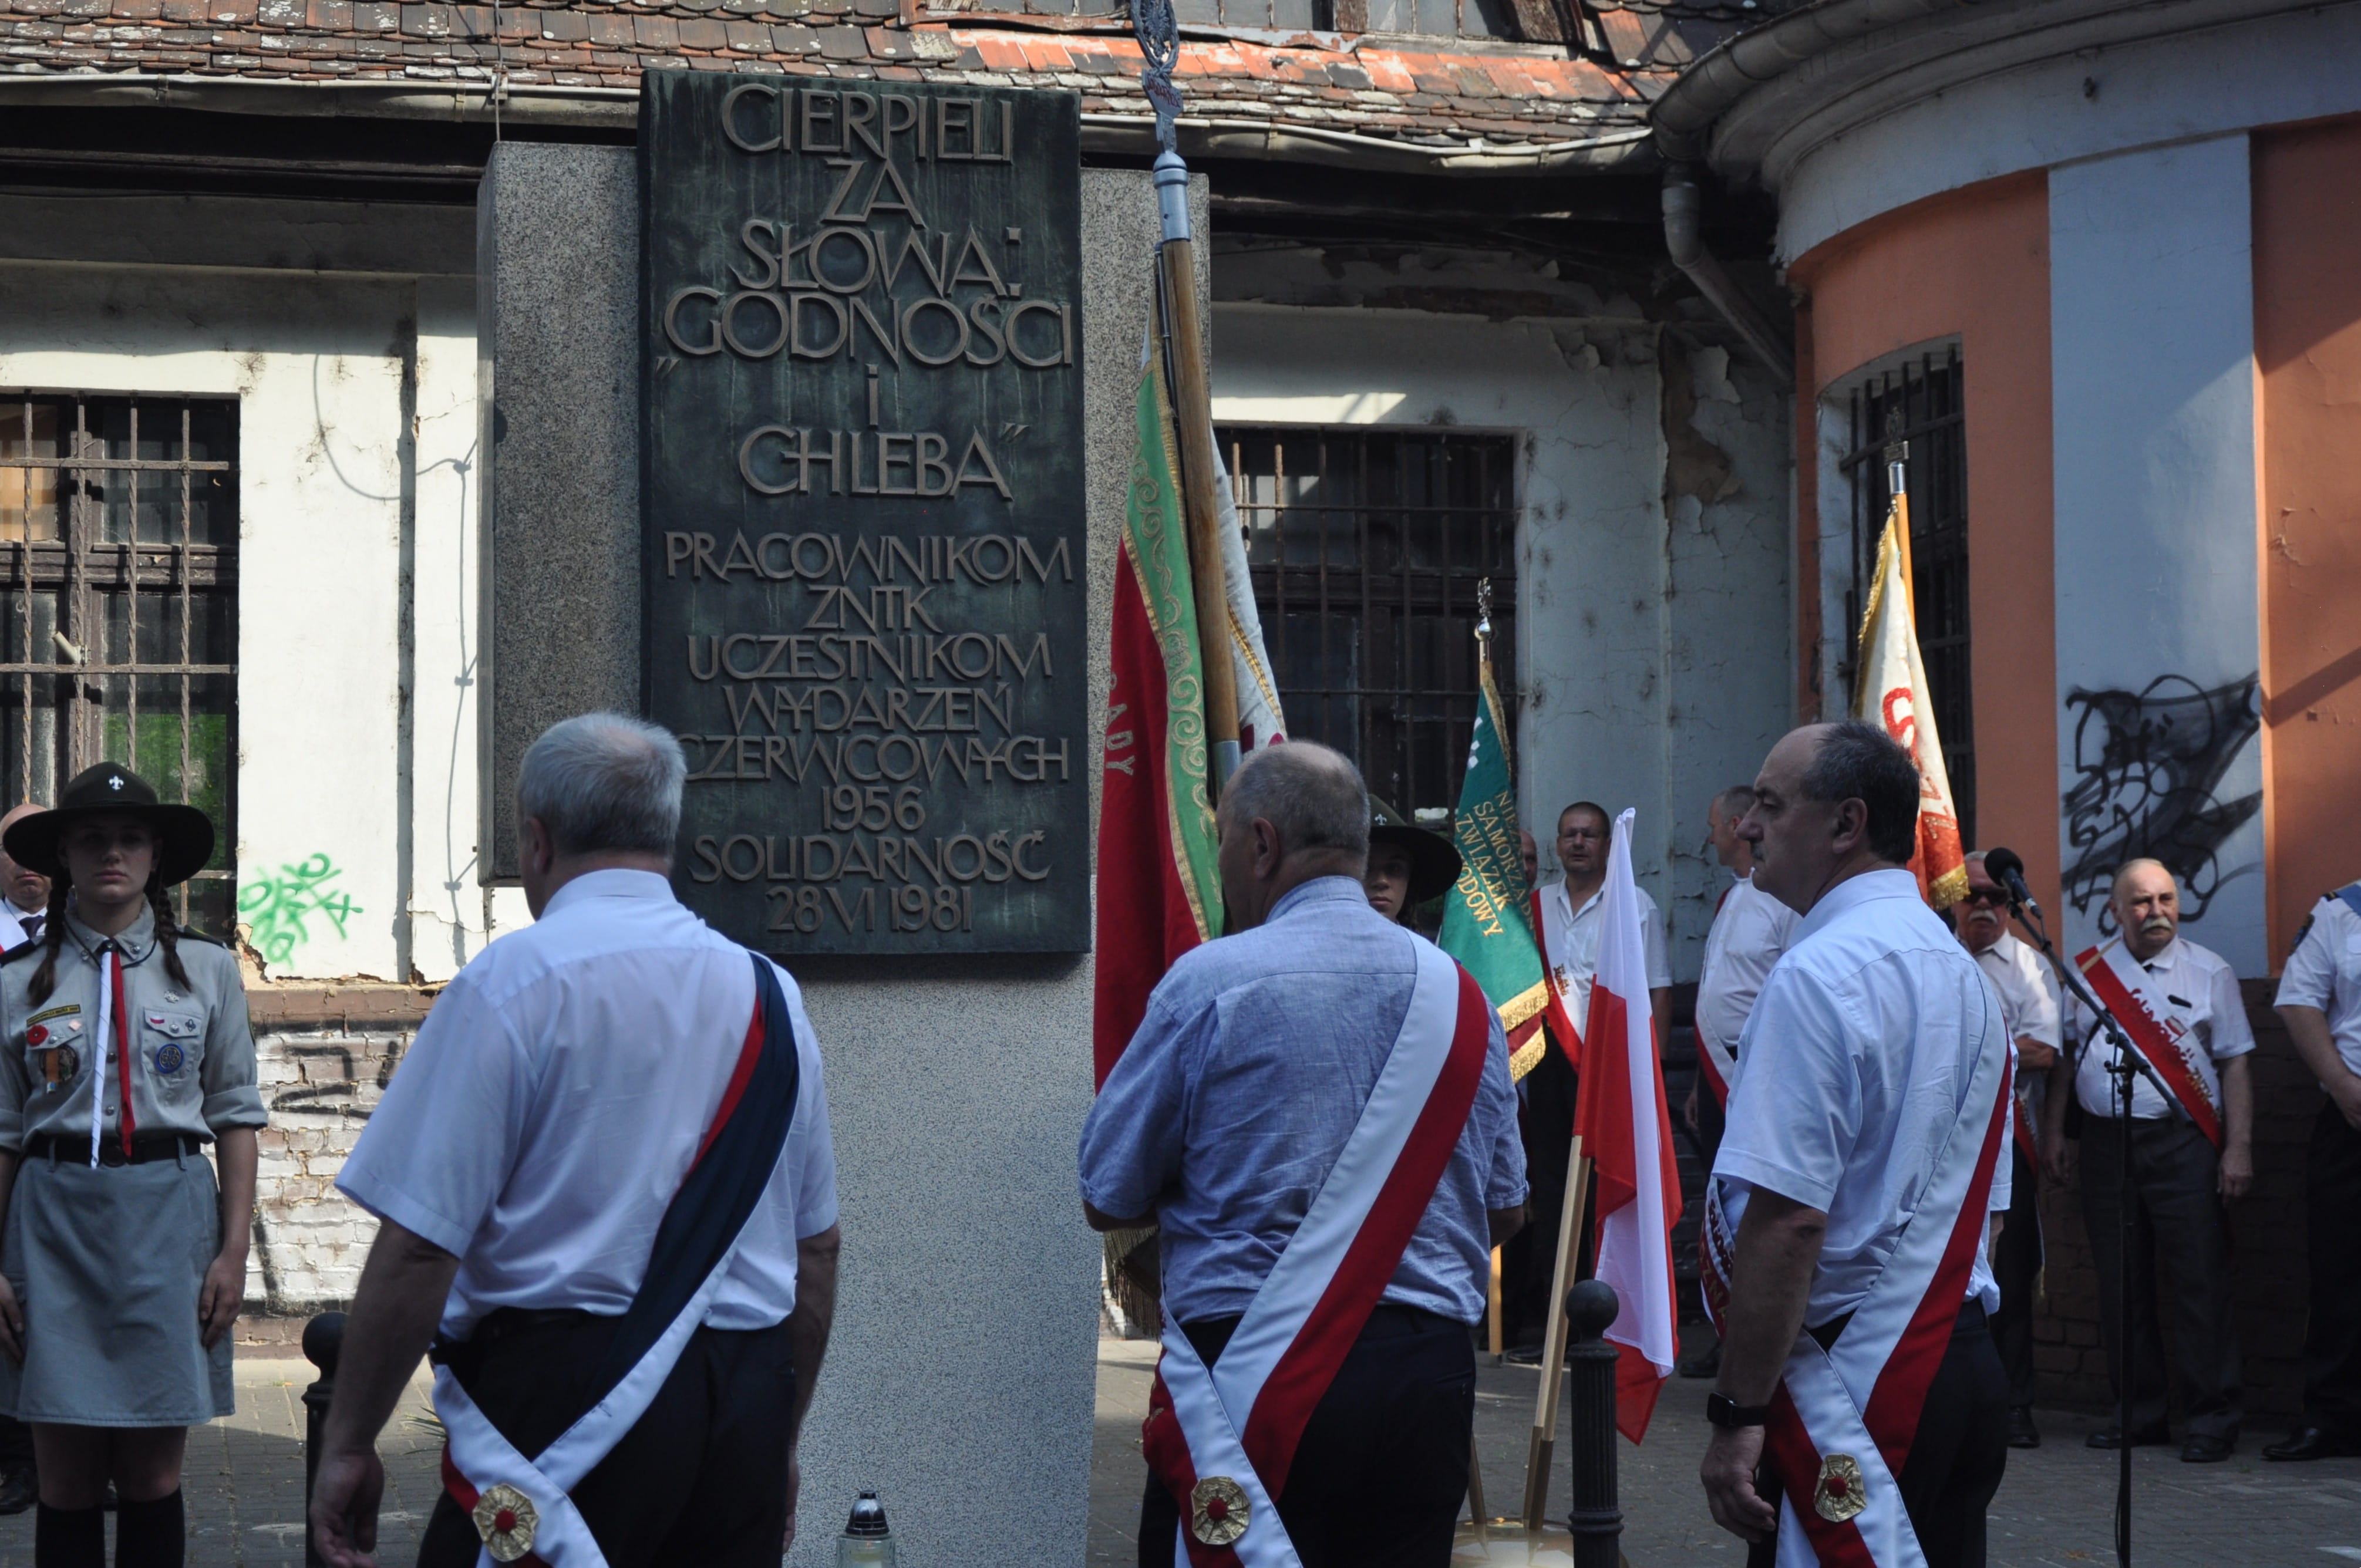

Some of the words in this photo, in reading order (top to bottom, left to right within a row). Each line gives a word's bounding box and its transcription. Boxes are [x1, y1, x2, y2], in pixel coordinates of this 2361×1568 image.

[722, 83, 1012, 163] CIERPIELI
[823, 156, 927, 229] ZA
[728, 220, 1021, 300] SŁOWA:
[865, 363, 878, 427] i
[665, 528, 1073, 585] PRACOWNIKOM
[805, 586, 942, 635] ZNTK
[687, 632, 1052, 683] UCZESTNIKOM
[725, 683, 1012, 736] WYDARZEŃ
[822, 785, 925, 832] 1956
[689, 831, 1052, 884] SOLIDARNOŚĆ
[766, 885, 823, 932] 28
[826, 888, 875, 933] VI
[891, 885, 972, 932] 1981
